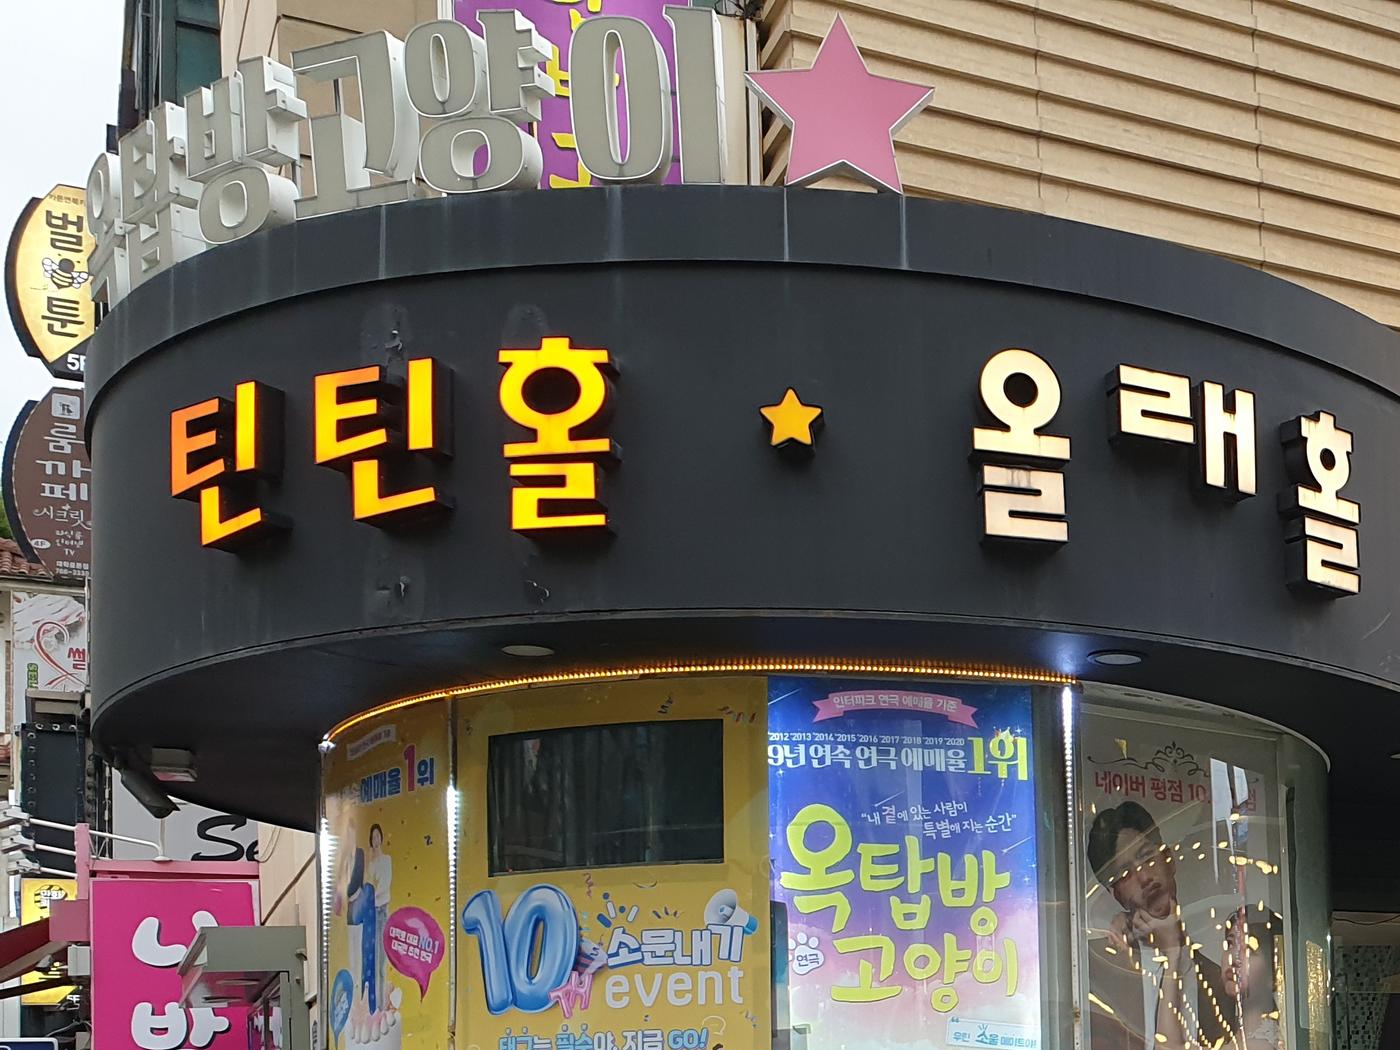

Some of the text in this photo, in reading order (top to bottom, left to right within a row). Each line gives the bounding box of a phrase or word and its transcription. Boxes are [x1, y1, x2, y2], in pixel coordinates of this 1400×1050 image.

[171, 337, 611, 547] 틴틴홀
[972, 348, 1361, 597] 올래홀
[833, 696, 876, 708] 인터파크
[878, 695, 899, 706] 연극
[936, 699, 958, 712] 기준
[768, 735, 1029, 780] 9년 연속 연극 예매율 1위
[1095, 771, 1146, 798] 네이버
[1151, 778, 1184, 803] 평점
[780, 803, 1011, 936] 옥탑방
[607, 923, 744, 969] 소문내기
[796, 952, 820, 967] 연극
[605, 967, 744, 1009] event
[831, 932, 1018, 1012] 고양이
